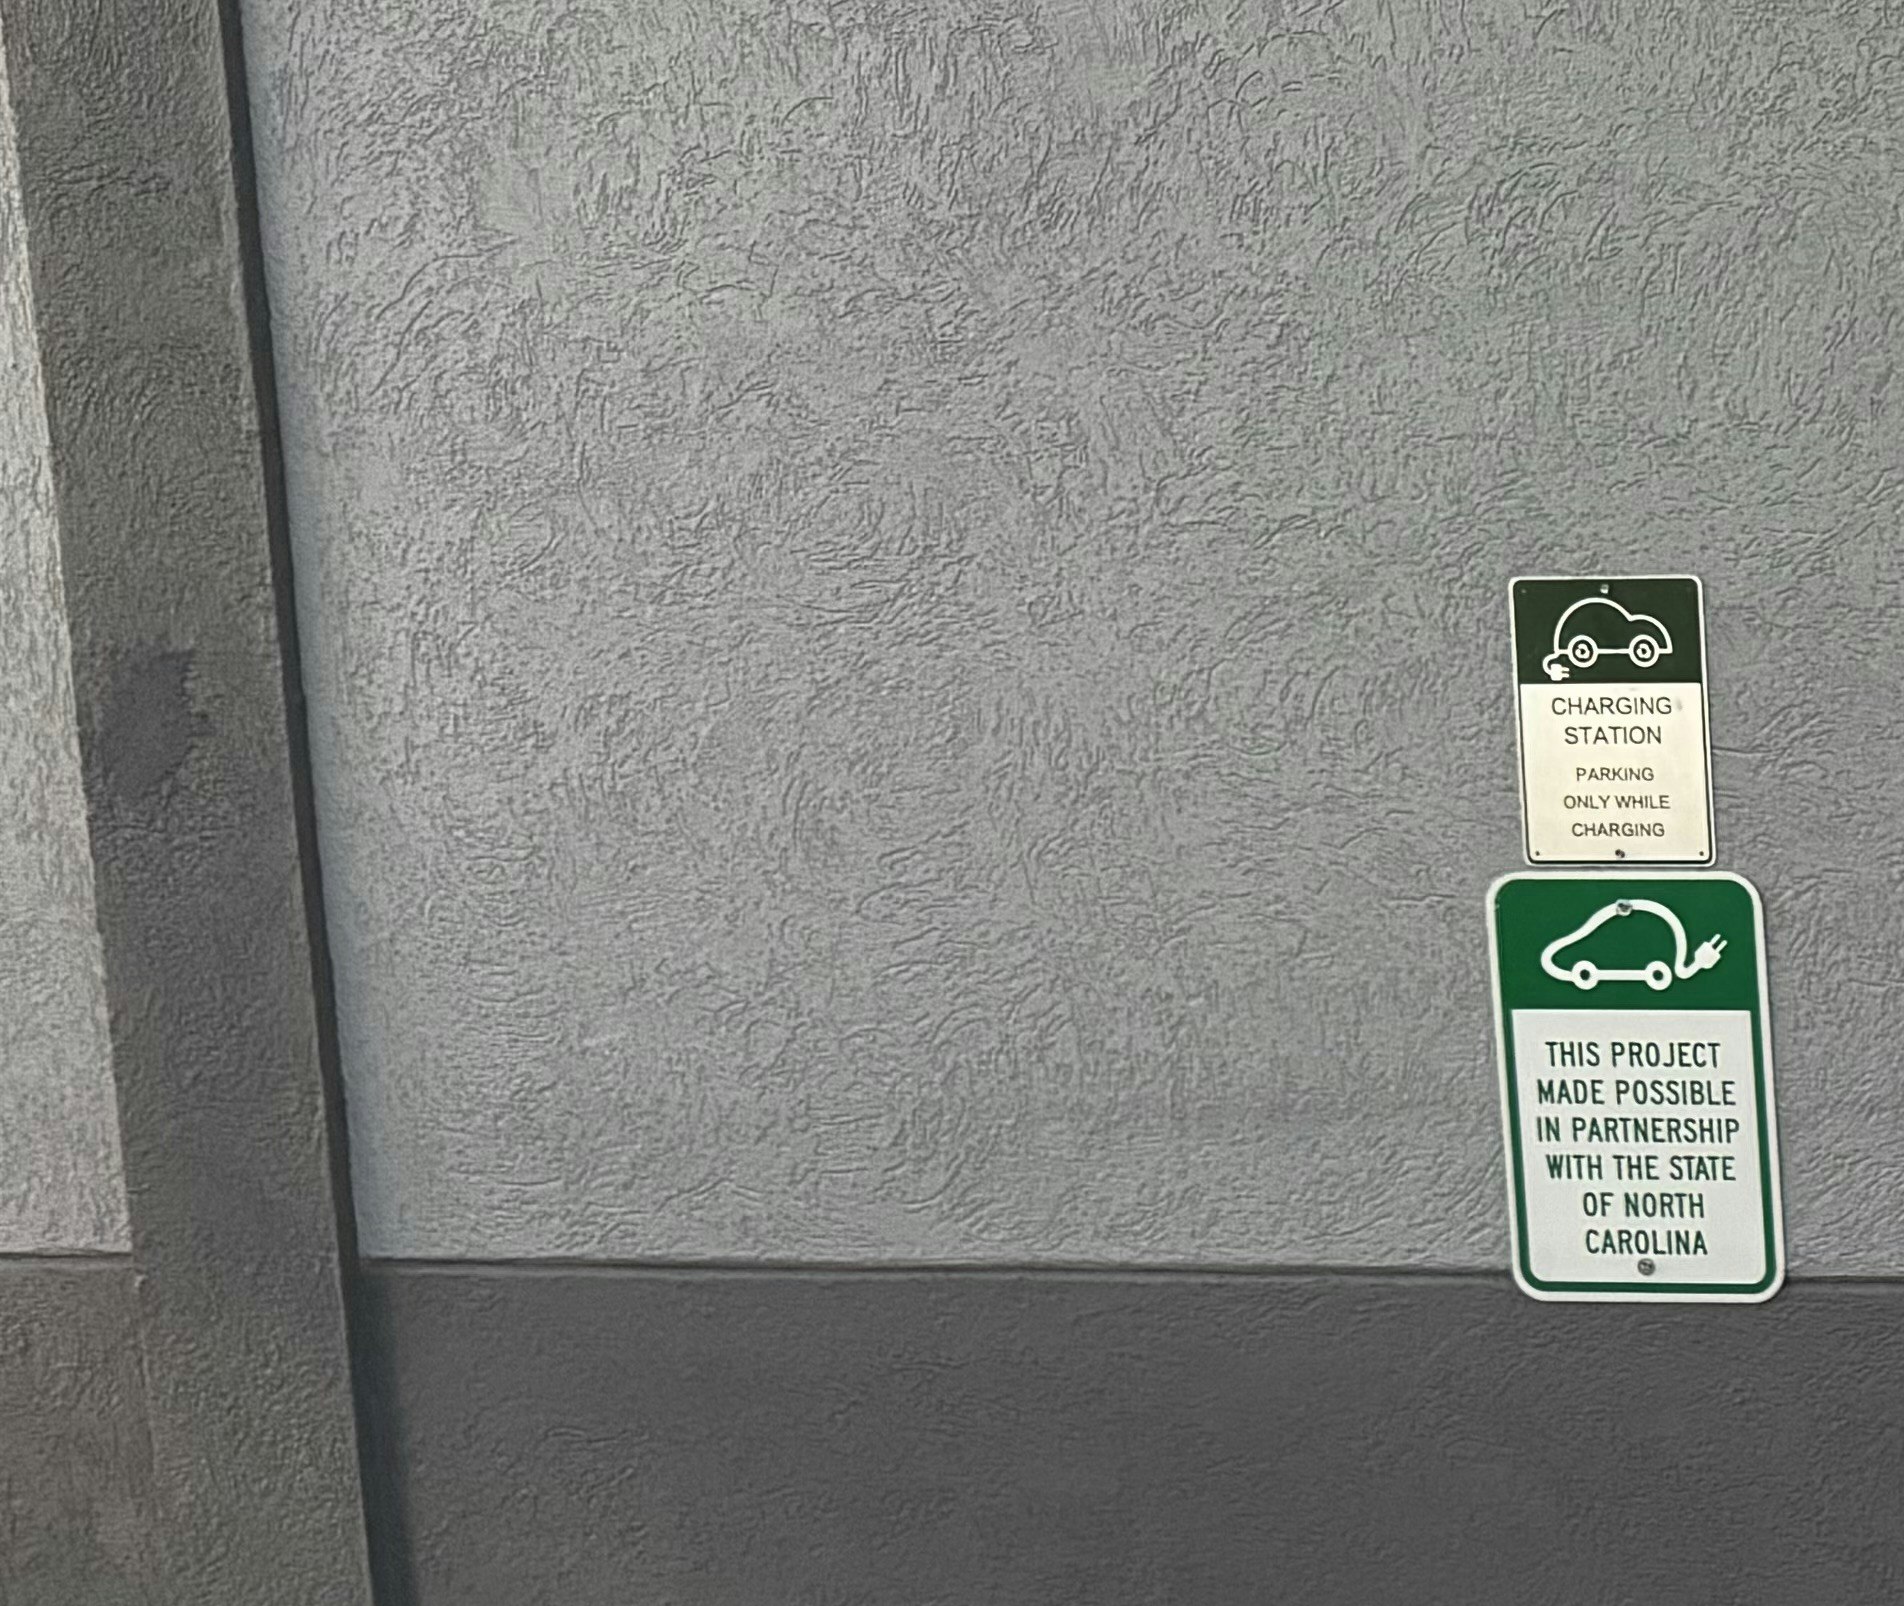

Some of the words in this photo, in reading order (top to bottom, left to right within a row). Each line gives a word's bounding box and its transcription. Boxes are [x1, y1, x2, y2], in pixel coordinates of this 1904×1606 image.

[1551, 696, 1672, 716] CHARGING
[1564, 725, 1662, 745] STATION
[1575, 766, 1655, 782] PARKING
[1563, 794, 1611, 810] ONLY
[1614, 794, 1671, 810] WHILE
[1571, 822, 1665, 838] CHARGING
[1544, 1040, 1601, 1068] THIS
[1610, 1041, 1721, 1069] PROJECT
[1536, 1078, 1606, 1106] MADE
[1615, 1079, 1737, 1106] POSSIBLE
[1536, 1116, 1561, 1143] IN
[1571, 1116, 1740, 1144] PARTNERSHIP
[1545, 1153, 1603, 1181] WITH
[1611, 1154, 1660, 1181] THE
[1669, 1154, 1737, 1182] STATE
[1582, 1191, 1615, 1218] OF
[1623, 1191, 1705, 1219] NORTH
[1585, 1228, 1709, 1256] CAROLINA
